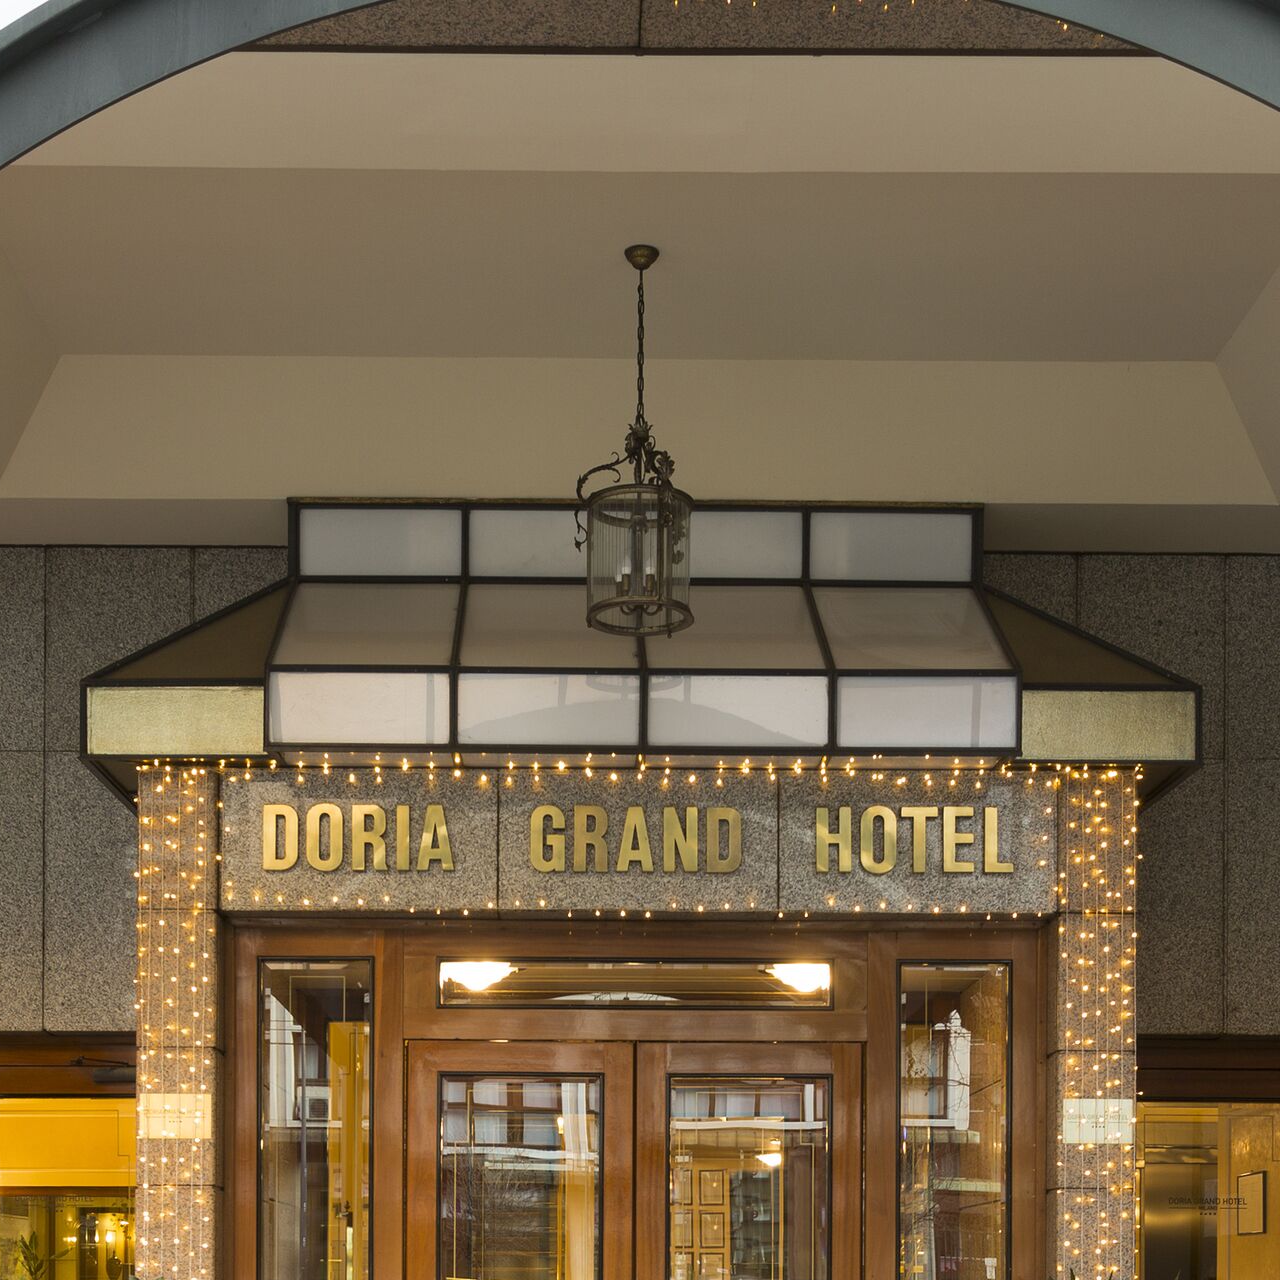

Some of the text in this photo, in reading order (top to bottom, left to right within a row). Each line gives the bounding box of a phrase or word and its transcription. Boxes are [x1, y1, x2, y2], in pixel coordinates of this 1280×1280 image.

[263, 803, 1014, 874] DORIA GRAND HOTEL
[1168, 1196, 1192, 1205] DORIA
[1222, 1197, 1248, 1206] HOTEL
